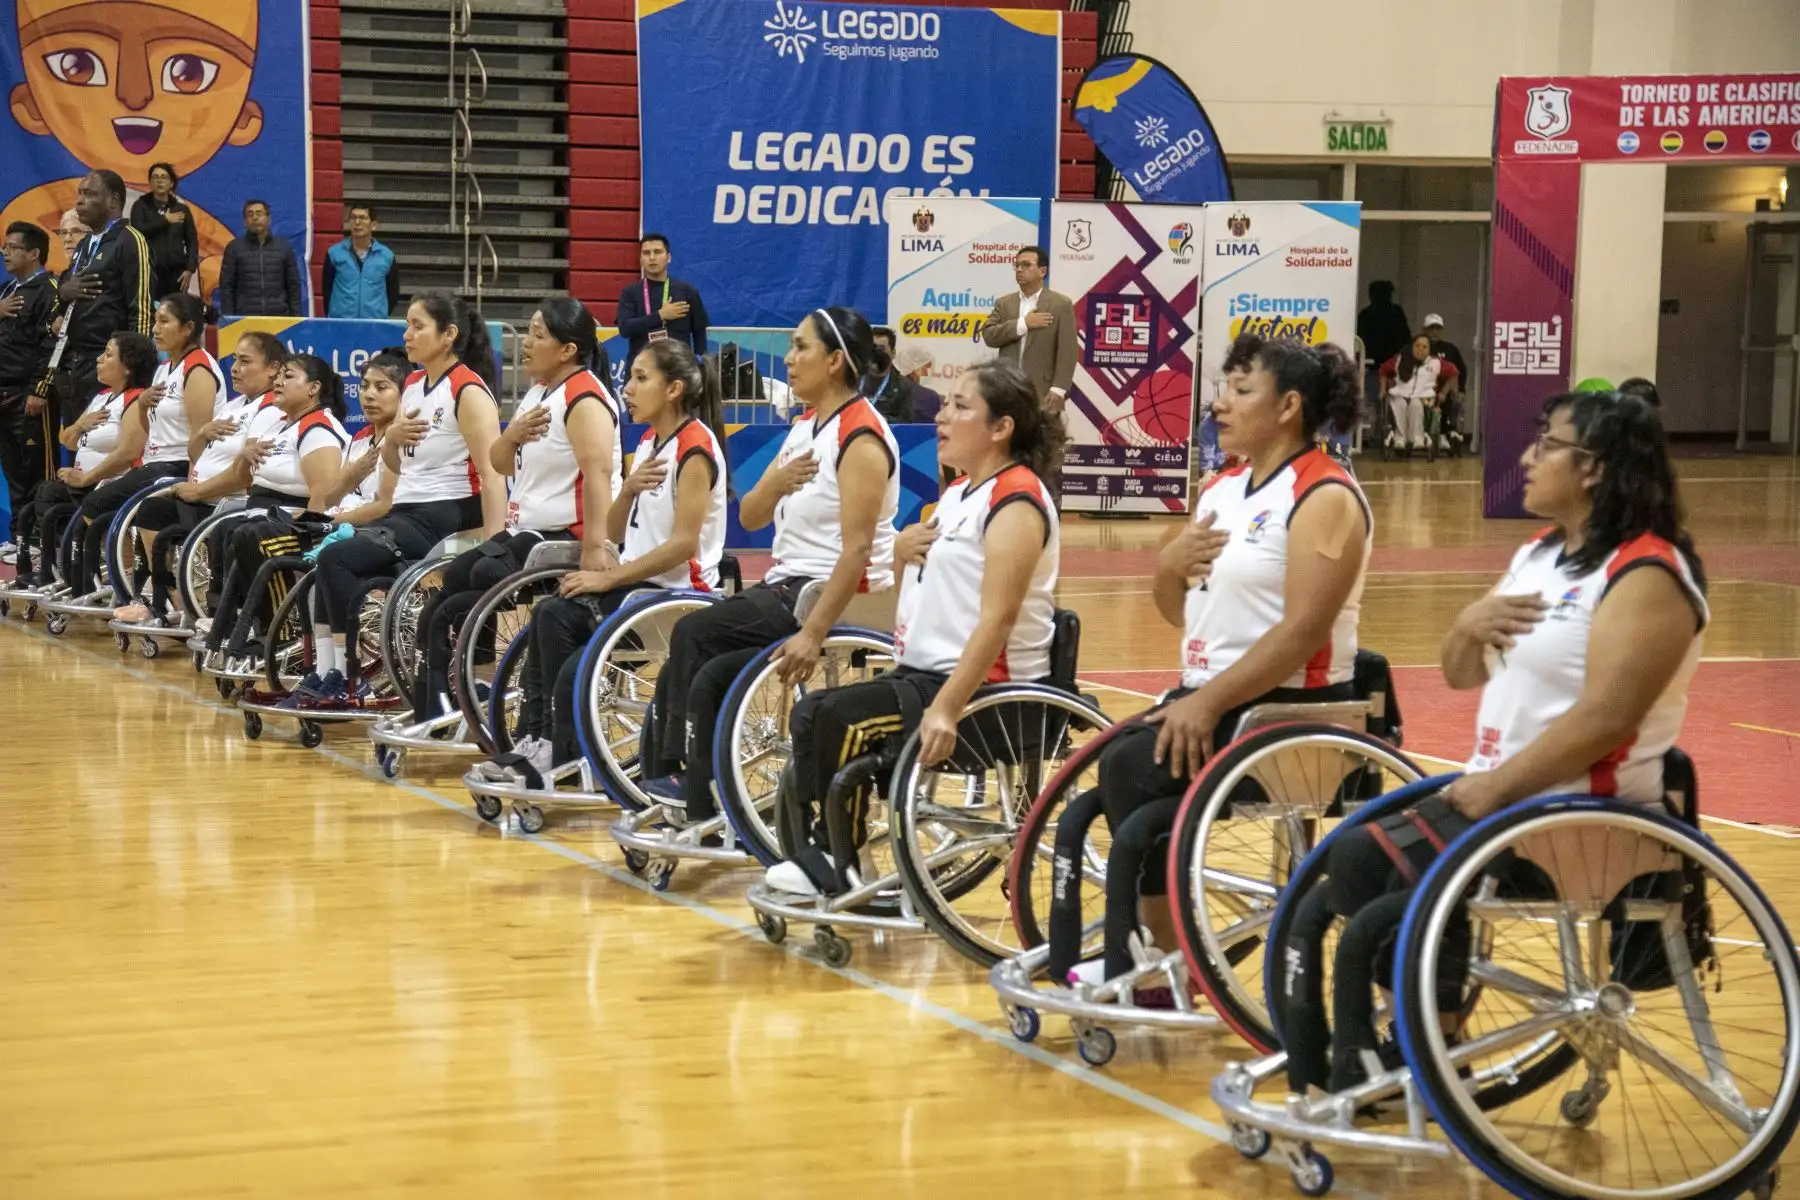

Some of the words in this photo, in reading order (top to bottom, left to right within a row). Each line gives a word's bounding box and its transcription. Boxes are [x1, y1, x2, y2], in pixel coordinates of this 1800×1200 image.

[823, 42, 885, 60] Seguimos
[888, 44, 939, 61] jugando
[1620, 84, 1691, 104] TORNEO
[1696, 83, 1720, 103] DE
[1619, 105, 1645, 127] DE
[1653, 105, 1690, 127] LAS
[1698, 104, 1800, 126] AMERICAS
[1327, 125, 1388, 151] SALIDA
[728, 131, 911, 173] LEGADO
[921, 136, 976, 175] ES
[901, 239, 944, 252] LIMA
[972, 243, 1006, 252] Hospital
[1216, 243, 1260, 256] LIMA
[1290, 246, 1325, 255] Hospital
[1328, 246, 1338, 254] de
[1341, 246, 1348, 254] la
[1285, 256, 1352, 267] Solidaridad
[921, 287, 971, 311] Aquí
[974, 295, 997, 307] tod
[902, 317, 922, 335] es
[927, 313, 969, 335] más
